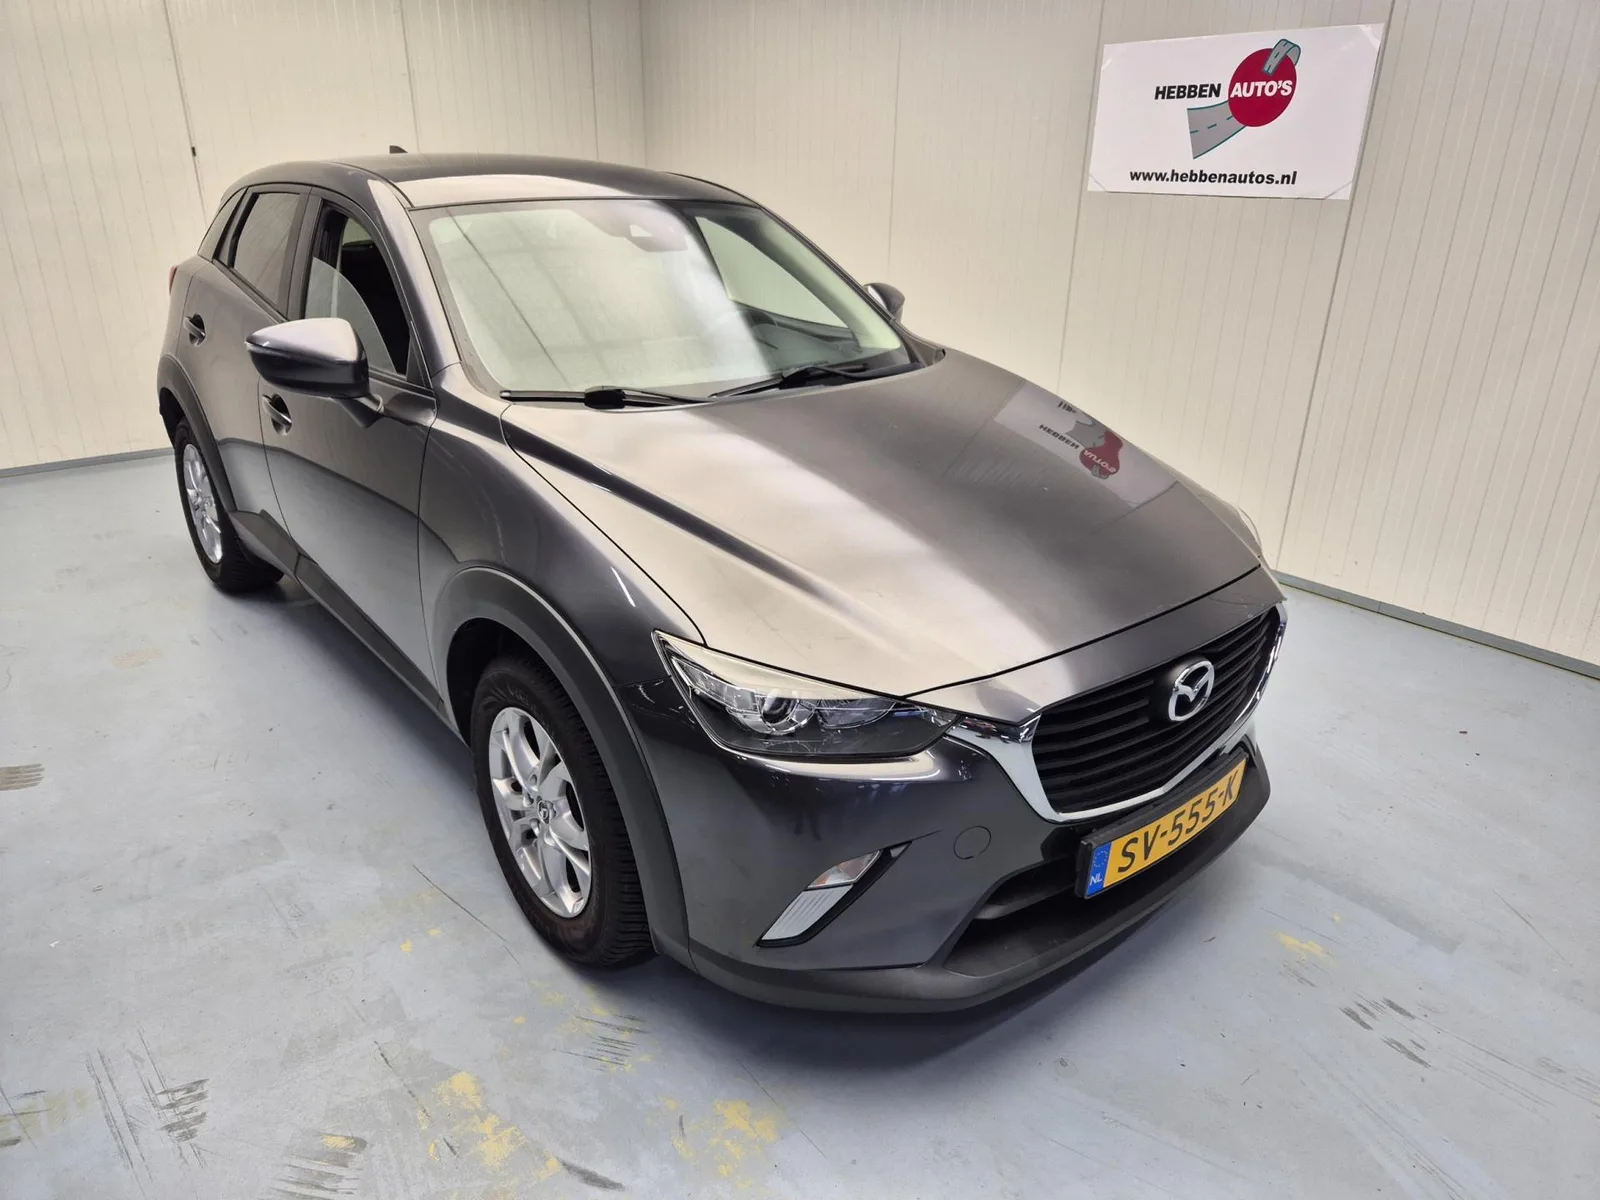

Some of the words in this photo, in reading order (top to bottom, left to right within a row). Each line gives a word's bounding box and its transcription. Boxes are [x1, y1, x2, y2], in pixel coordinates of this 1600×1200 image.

[1154, 83, 1221, 100] HEBBEN
[1230, 80, 1293, 98] AUTO'S
[1129, 169, 1297, 185] www.hebbenautos.nl
[1118, 770, 1238, 873] SV-555-K
[1090, 872, 1103, 886] NL
